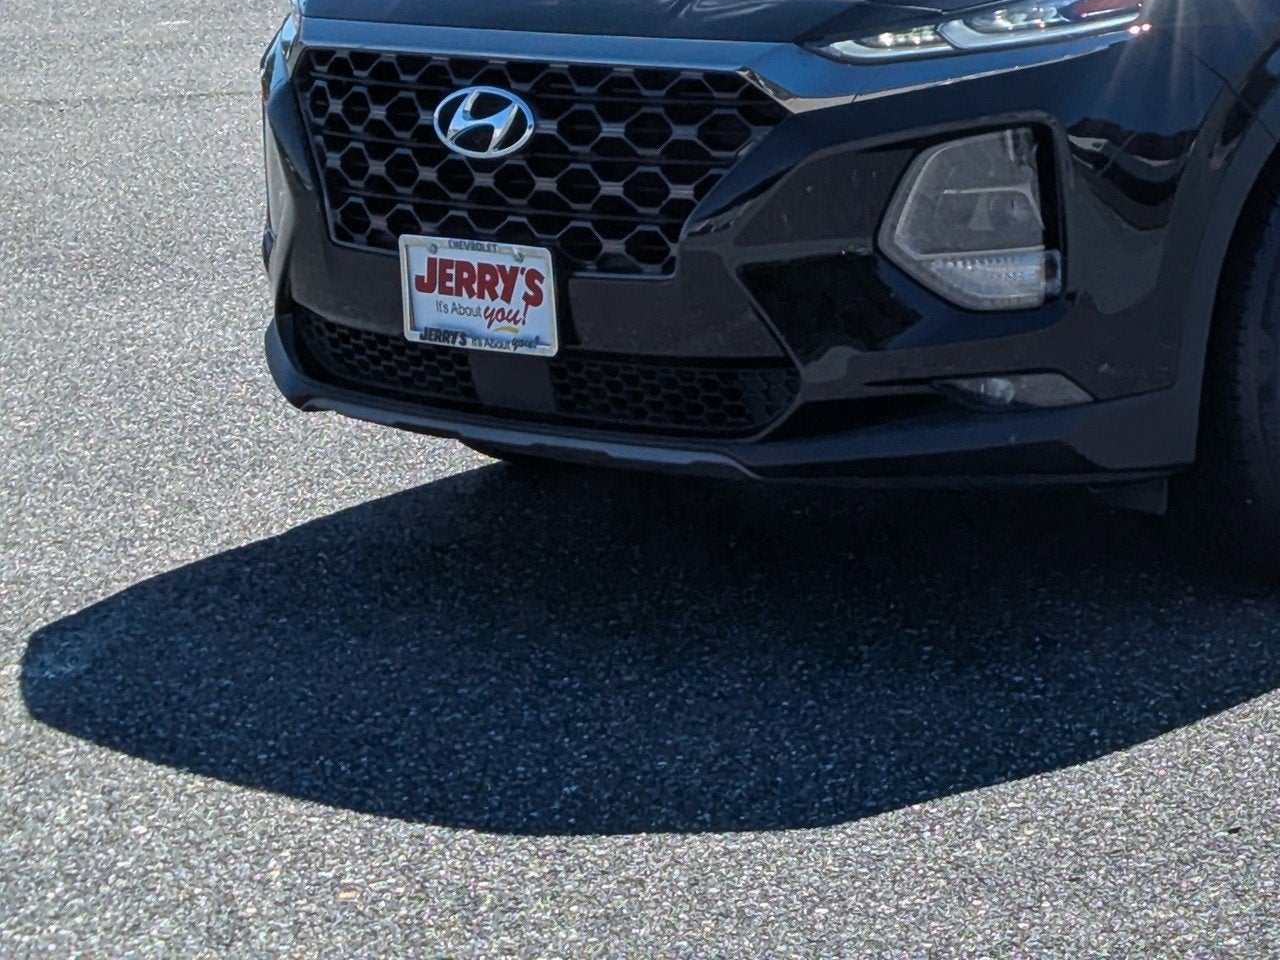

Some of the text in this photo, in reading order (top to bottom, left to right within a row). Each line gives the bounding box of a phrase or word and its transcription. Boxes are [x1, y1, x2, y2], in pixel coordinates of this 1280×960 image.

[448, 239, 498, 253] CHEVROLET
[415, 256, 545, 308] JERRY'S
[483, 302, 530, 329] you!
[419, 326, 468, 346] JERRY'S
